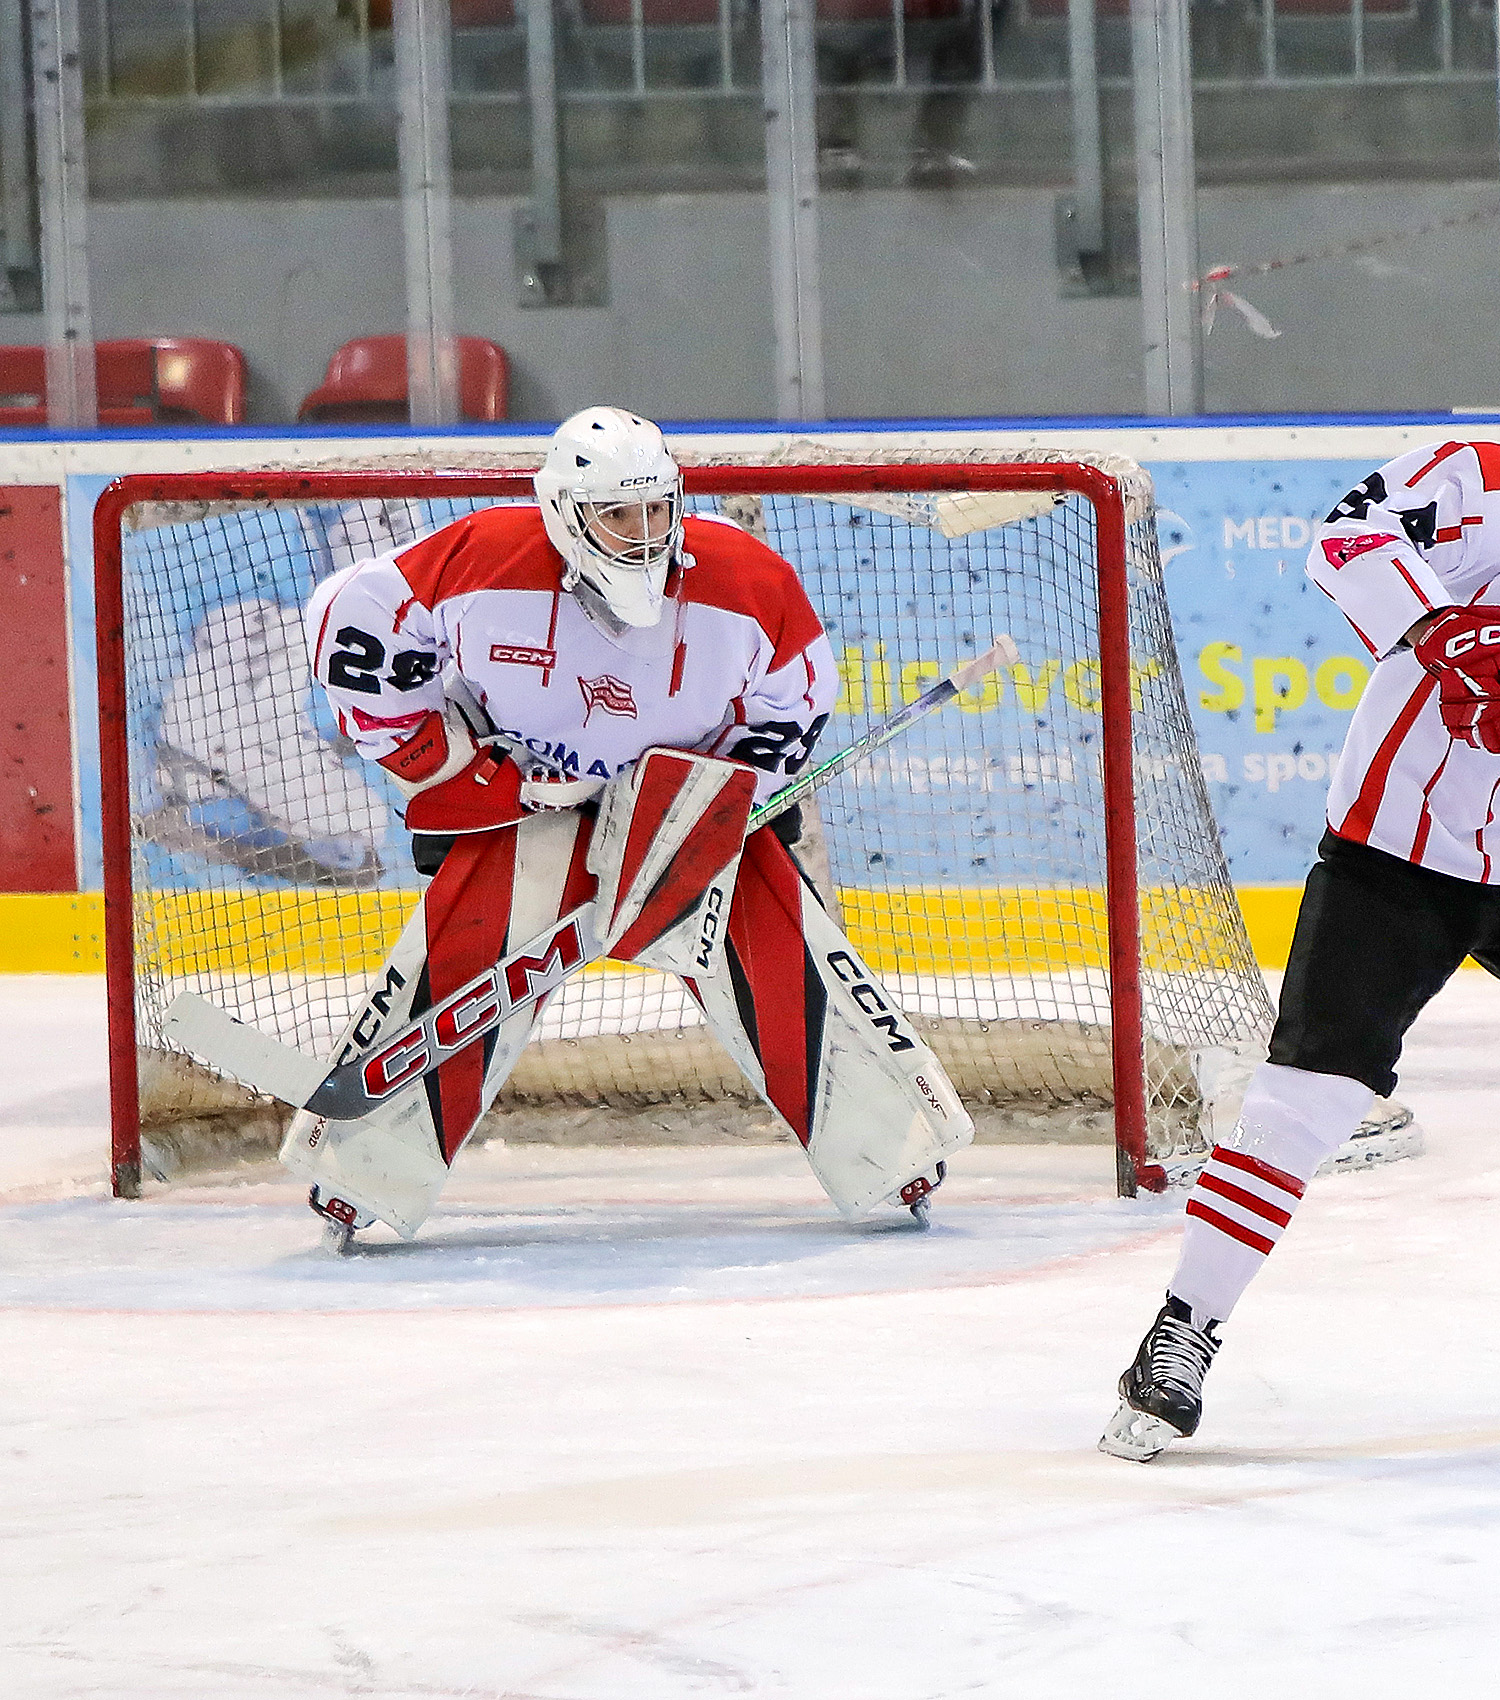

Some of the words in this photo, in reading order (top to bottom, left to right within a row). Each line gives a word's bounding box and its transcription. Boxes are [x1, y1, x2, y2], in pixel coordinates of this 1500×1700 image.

[619, 475, 658, 487] CCM
[493, 649, 553, 665] CCM
[400, 738, 434, 768] CCM
[696, 886, 724, 970] CCM
[362, 916, 586, 1100] CCM
[827, 950, 916, 1053] CCM
